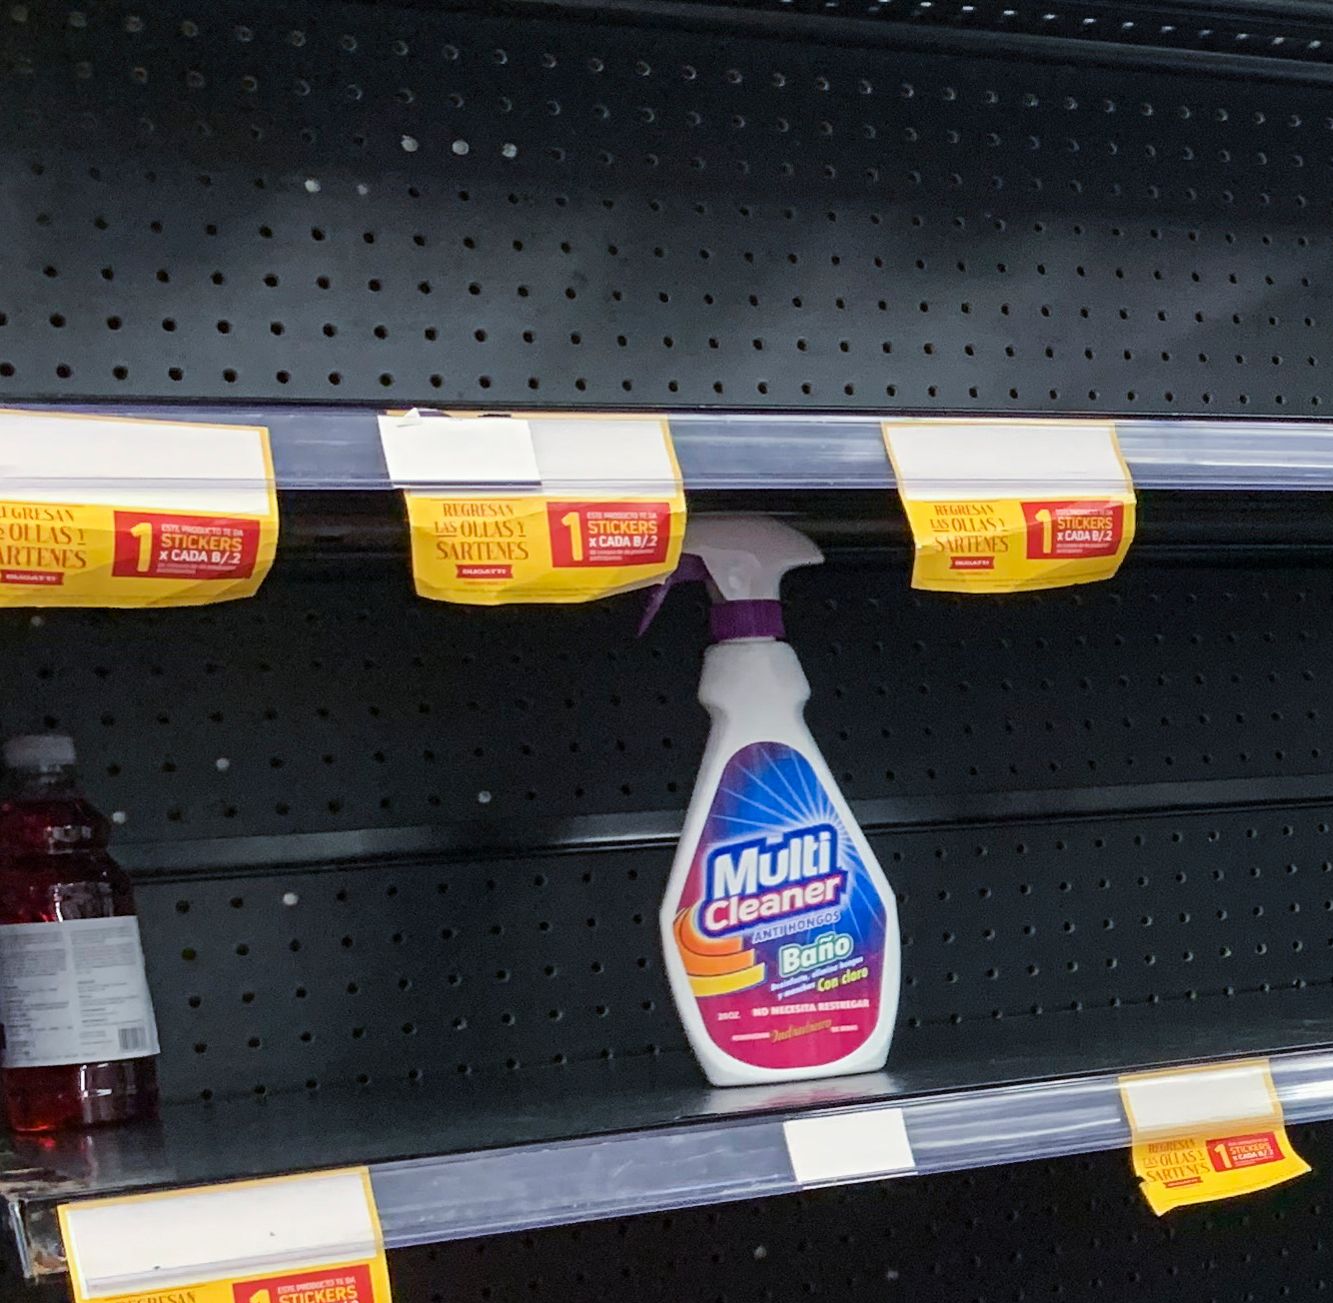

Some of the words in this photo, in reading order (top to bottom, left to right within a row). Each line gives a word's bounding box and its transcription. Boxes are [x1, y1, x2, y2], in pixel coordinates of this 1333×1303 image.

[443, 503, 515, 518] REGRESAN
[934, 504, 994, 516] REGRESAN
[434, 521, 458, 537] LAS
[460, 520, 515, 538] OLLAS
[588, 520, 658, 534] STICKERS
[951, 517, 997, 533] OLLAS
[1034, 508, 1053, 554] 1
[1057, 516, 1113, 531] STICKERS
[9, 522, 73, 546] OLLAS
[161, 533, 243, 552] STICKERS
[561, 512, 584, 561] 1
[599, 537, 631, 548] CADA
[1065, 530, 1091, 542] CADA
[129, 522, 153, 573] 1
[436, 541, 529, 561] SARTENES
[935, 535, 1009, 553] SARTENES
[171, 549, 207, 564] CADA
[713, 830, 831, 900] Multi
[704, 875, 841, 931] Cleaner
[780, 934, 852, 975] Baño
[1214, 1143, 1233, 1168] 1
[1146, 1162, 1211, 1181] SARTENES
